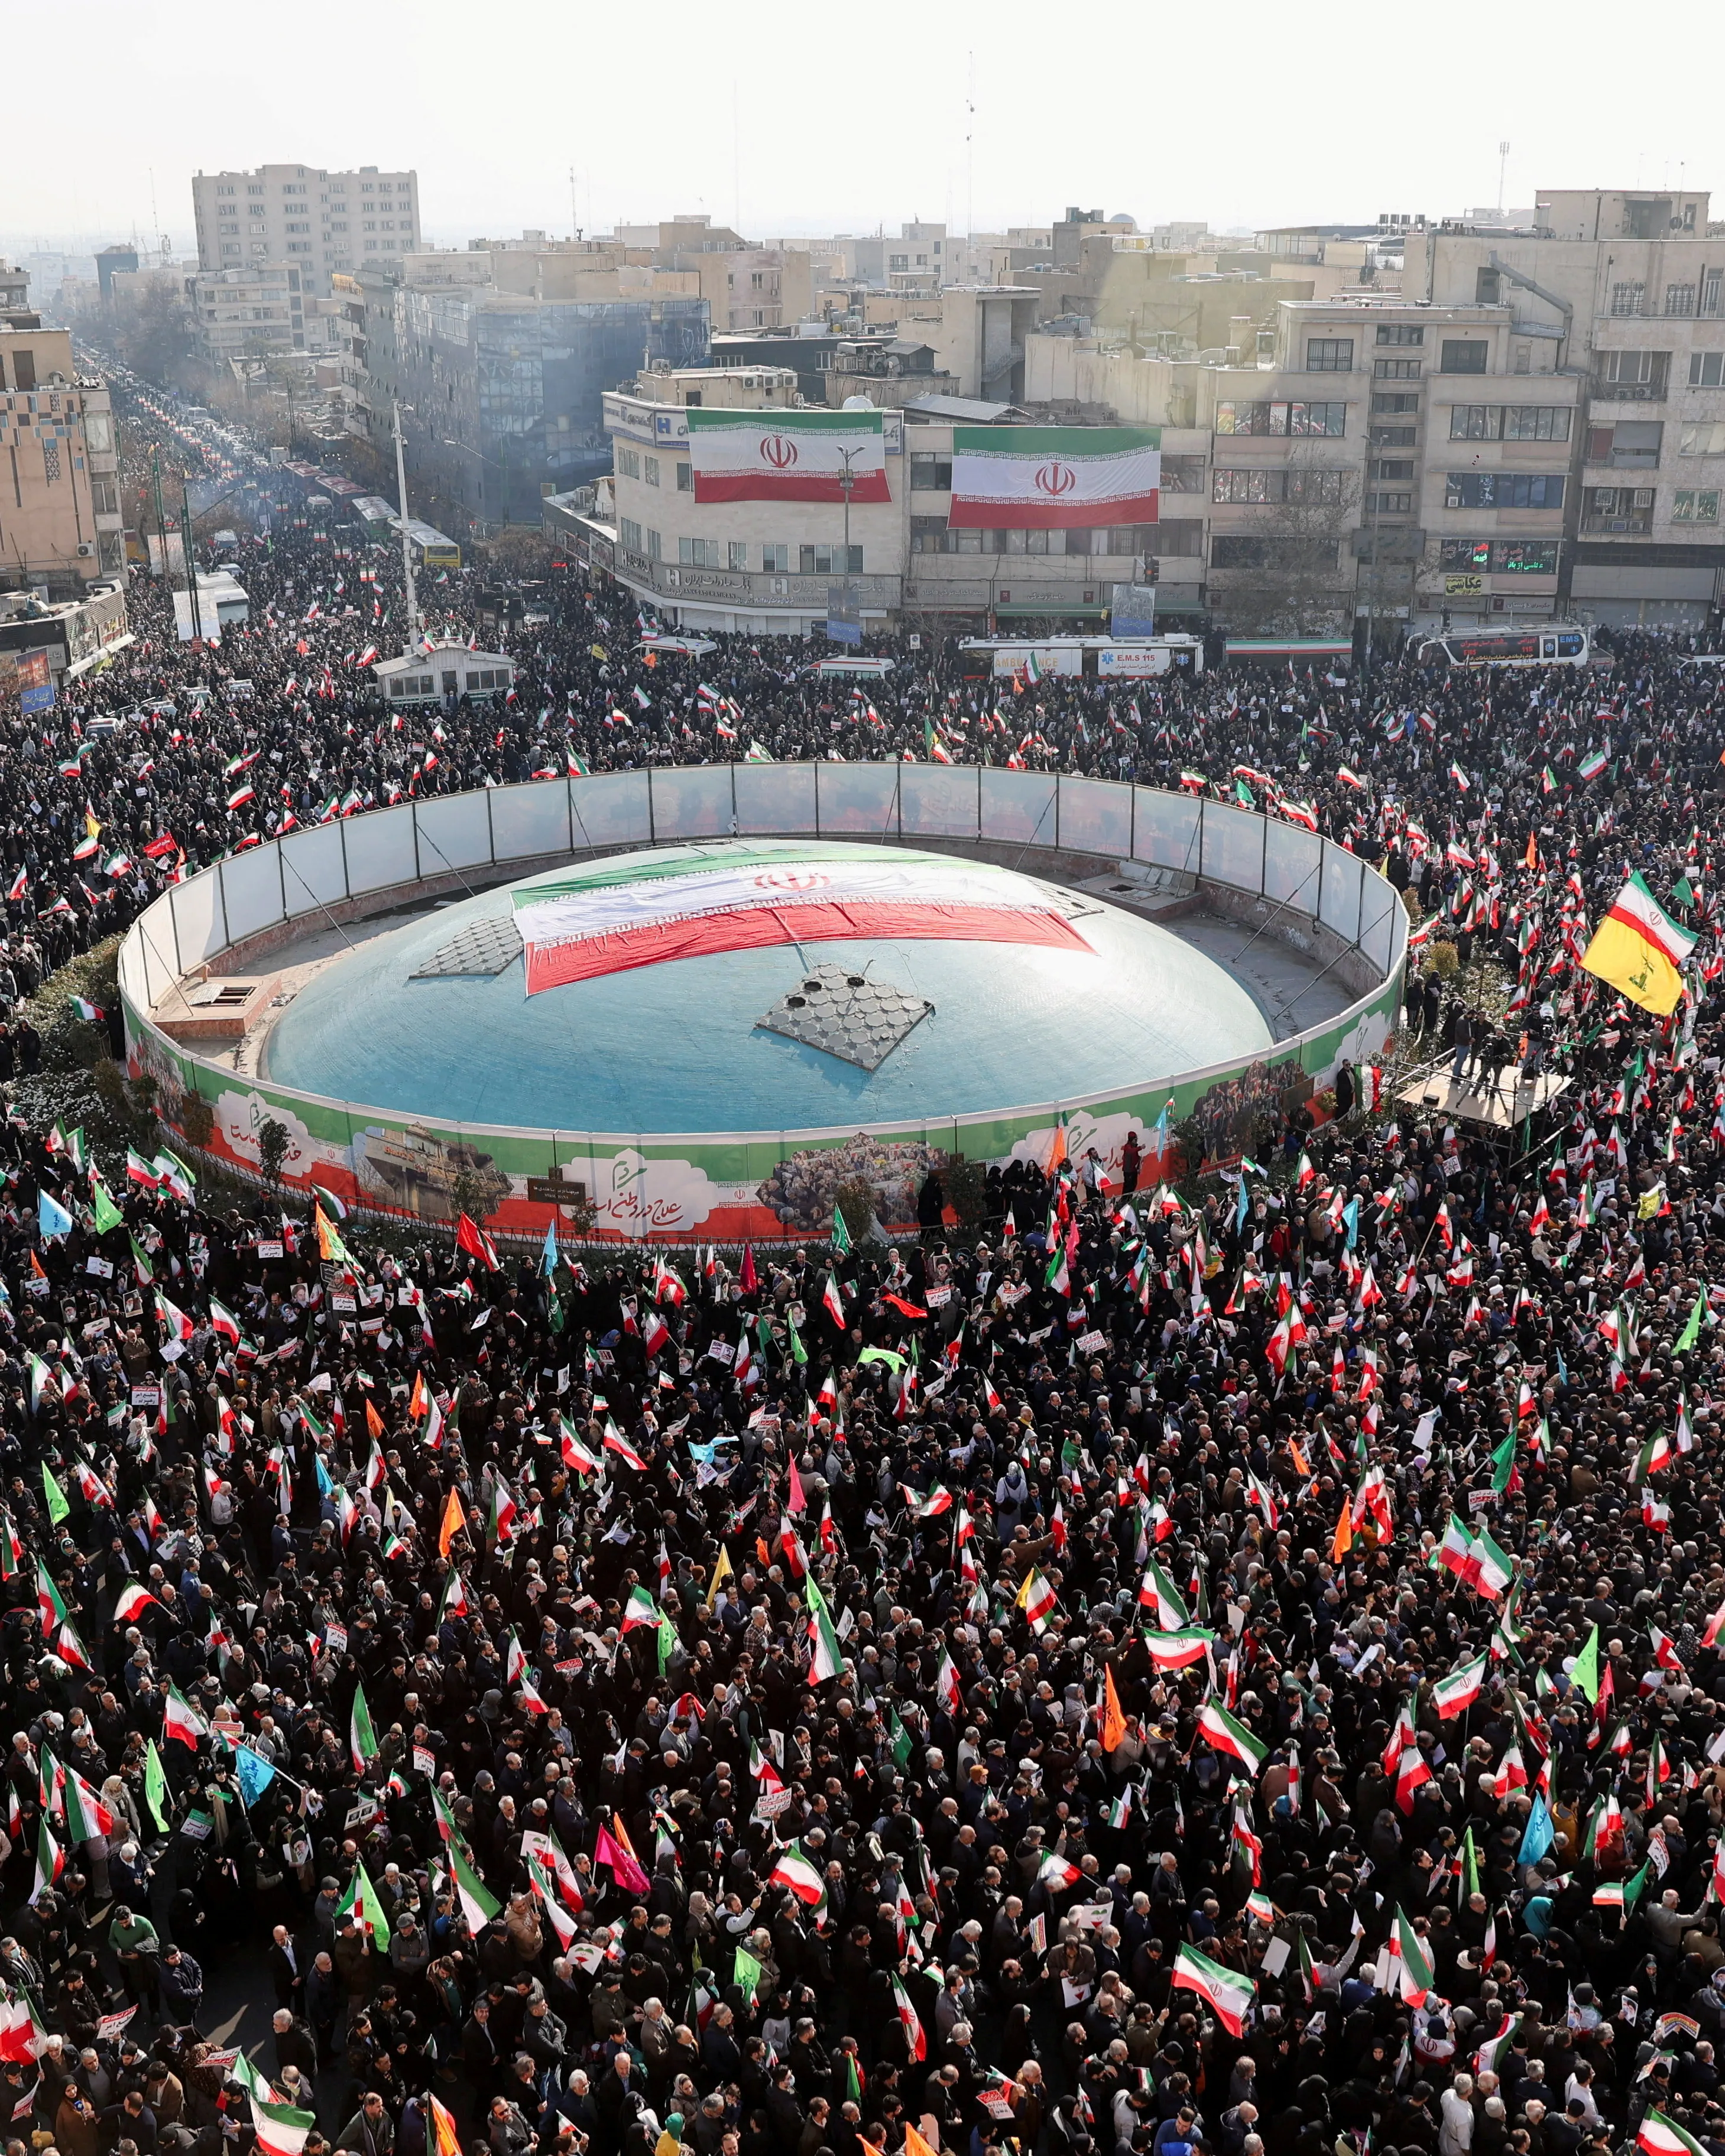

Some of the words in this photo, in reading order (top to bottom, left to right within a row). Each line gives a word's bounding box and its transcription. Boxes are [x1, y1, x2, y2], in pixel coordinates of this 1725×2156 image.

[685, 574, 703, 587] ایران
[702, 574, 731, 587] صادرات
[732, 575, 751, 594] بانک
[792, 580, 816, 593] ایران
[858, 577, 882, 596] بانک
[1446, 576, 1482, 593] عکاسی
[696, 589, 721, 598] SADERAT
[955, 587, 970, 597] کباب
[1027, 592, 1048, 600] زندگی
[1559, 635, 1580, 644] EMS
[996, 657, 1058, 667] AMBUNCE
[249, 1102, 271, 1129] مردم
[1068, 1125, 1098, 1156] مردم
[612, 1160, 647, 1192] مردم
[611, 1191, 642, 1220] وطن
[651, 1199, 683, 1226] علاج
[549, 1300, 559, 1316] مطیع
[337, 1632, 346, 1641] مطیع
[425, 1756, 434, 1766] مطیع
[759, 1806, 776, 1814] اسرائیل
[1533, 1809, 1546, 1831] مطیع
[105, 2022, 116, 2031] امر
[116, 2015, 133, 2027] مطیع
